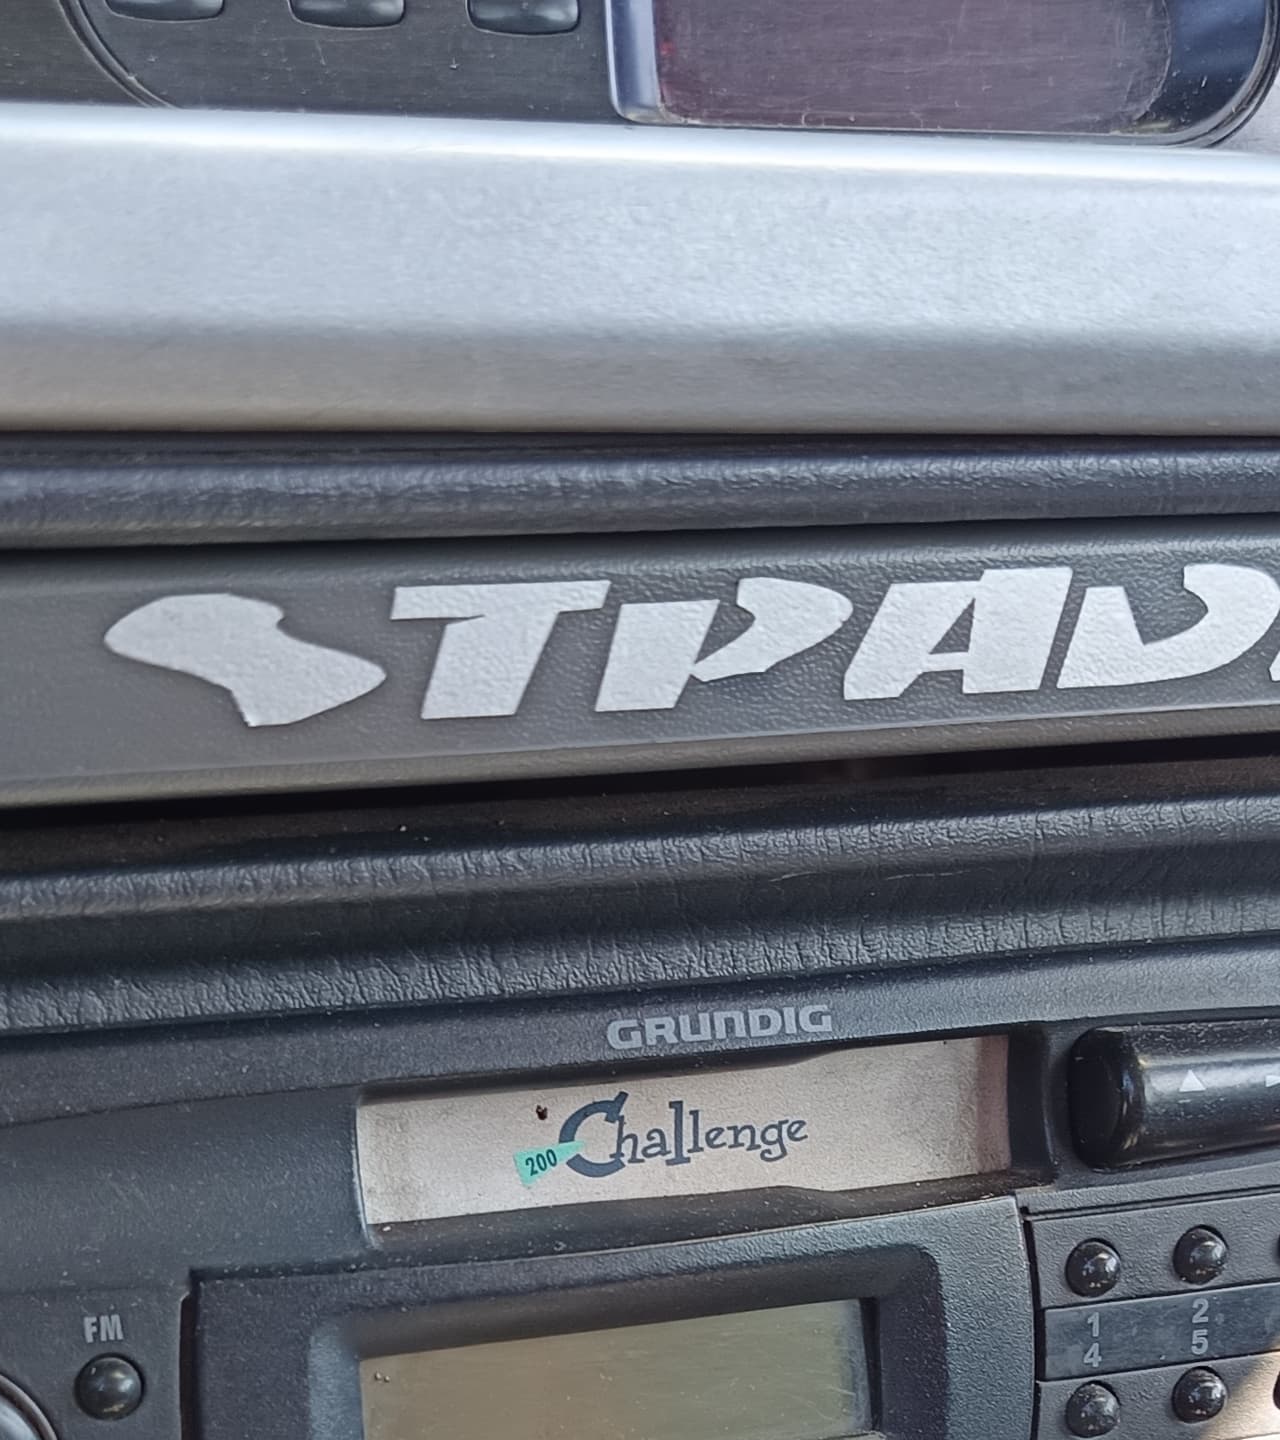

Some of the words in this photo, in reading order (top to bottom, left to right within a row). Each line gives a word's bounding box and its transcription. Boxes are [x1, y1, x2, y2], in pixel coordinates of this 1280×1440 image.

[606, 1003, 832, 1051] GRUNDIG
[524, 1148, 559, 1178] 200
[558, 1090, 808, 1179] Challenge
[84, 1315, 124, 1343] FM
[1086, 1313, 1100, 1338] 1
[1192, 1300, 1209, 1325] 2
[1083, 1343, 1102, 1368] 4
[1191, 1330, 1209, 1355] 5
